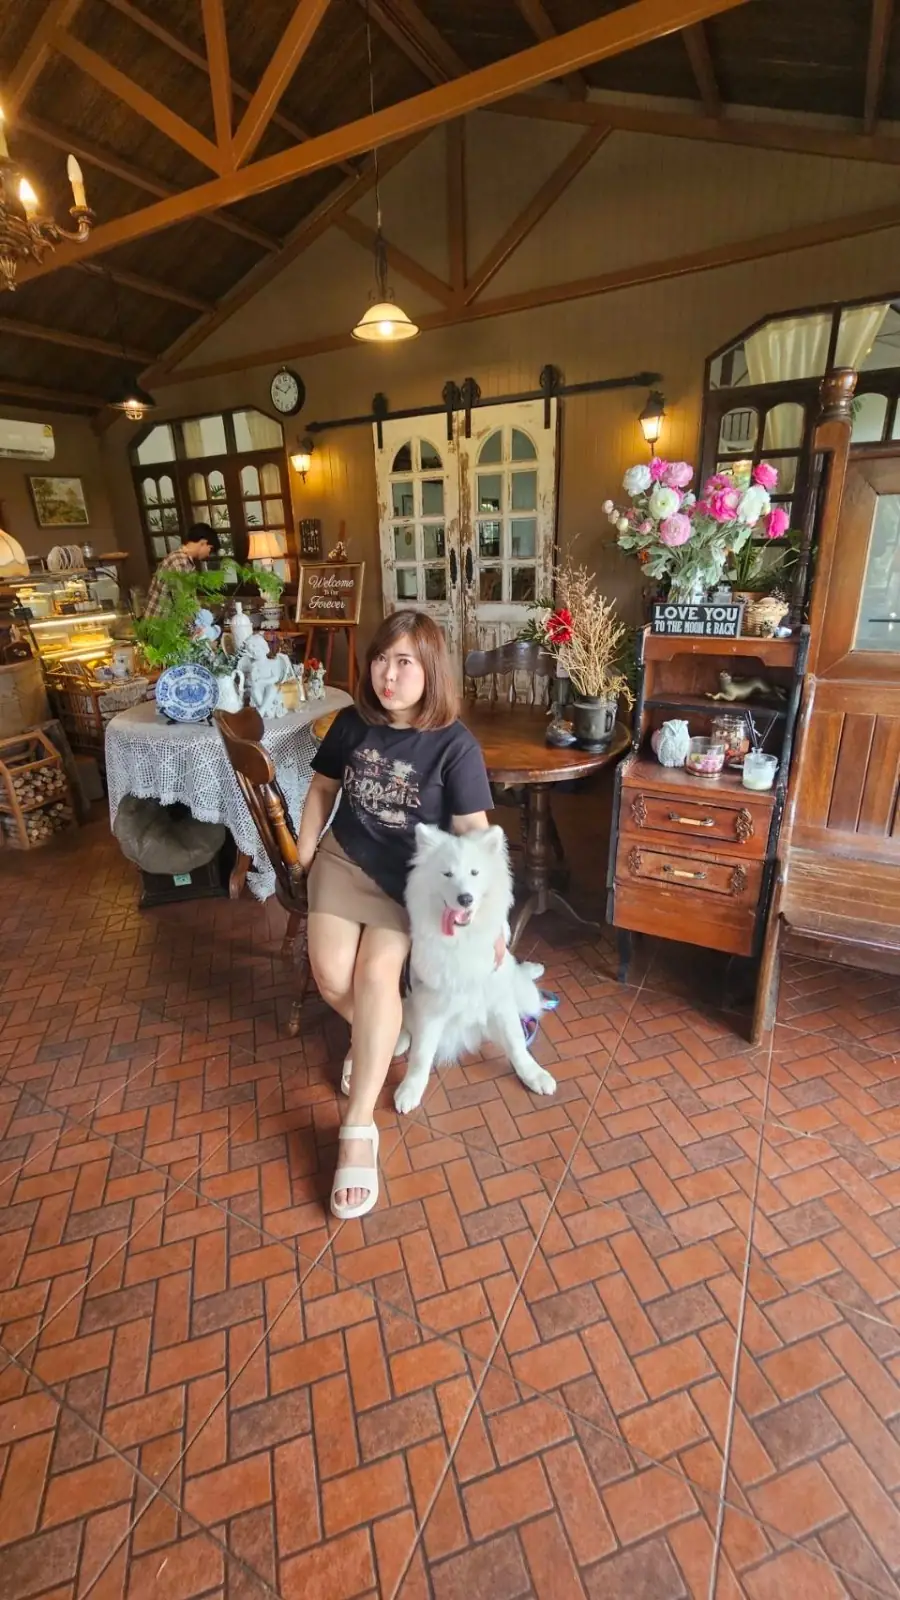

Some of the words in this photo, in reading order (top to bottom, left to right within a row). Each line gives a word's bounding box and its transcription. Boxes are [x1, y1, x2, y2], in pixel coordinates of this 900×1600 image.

[308, 574, 354, 589] Welcome
[308, 595, 345, 609] Forever
[654, 605, 699, 620] LOVE
[704, 607, 739, 621] YOU
[654, 620, 666, 632] TO
[667, 621, 683, 633] THE
[683, 621, 705, 634] MOON
[706, 622, 712, 634] &
[713, 622, 736, 635] BACK
